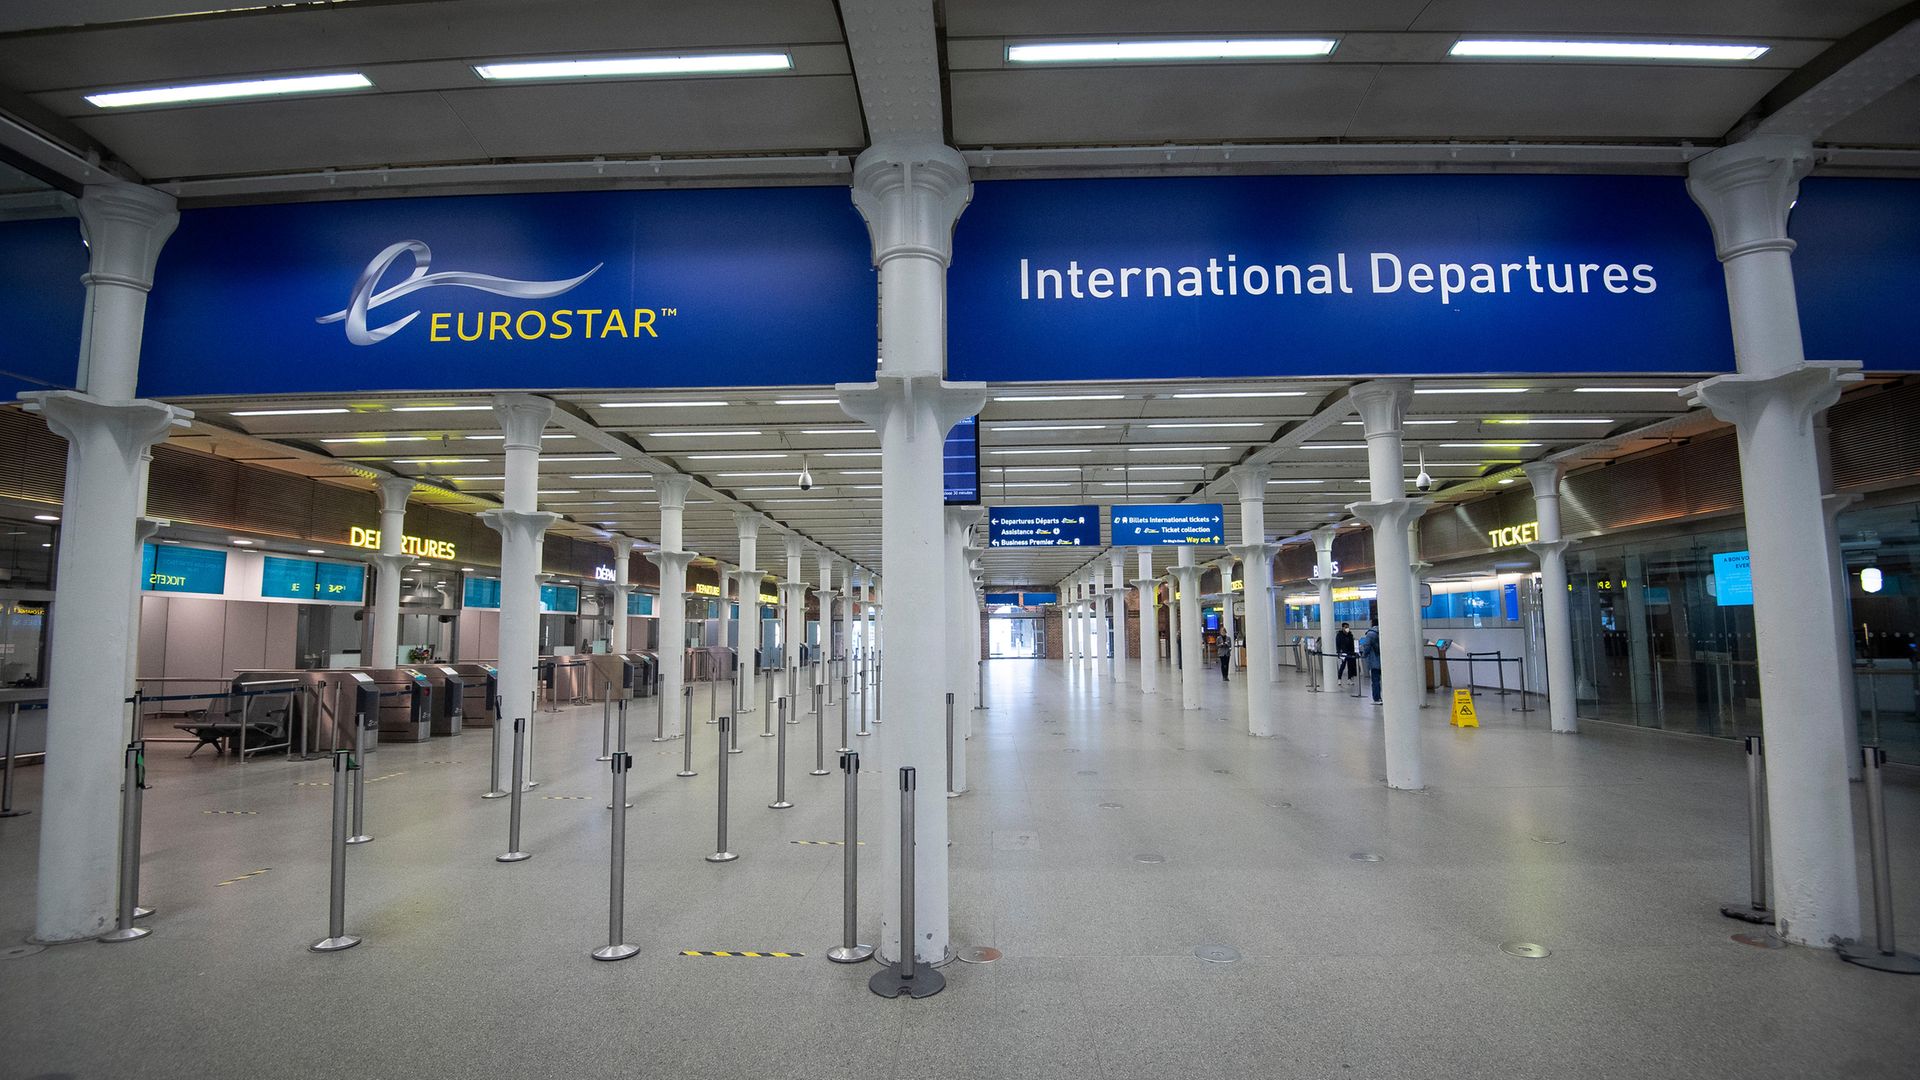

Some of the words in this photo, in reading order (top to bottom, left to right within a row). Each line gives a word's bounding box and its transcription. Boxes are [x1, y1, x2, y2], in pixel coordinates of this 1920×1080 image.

[1020, 252, 1353, 300] International
[1370, 252, 1657, 305] Departures
[1000, 518, 1034, 526] Departures
[1035, 517, 1059, 526] Départs
[350, 526, 456, 560] DERTURES
[1186, 536, 1199, 544] Way
